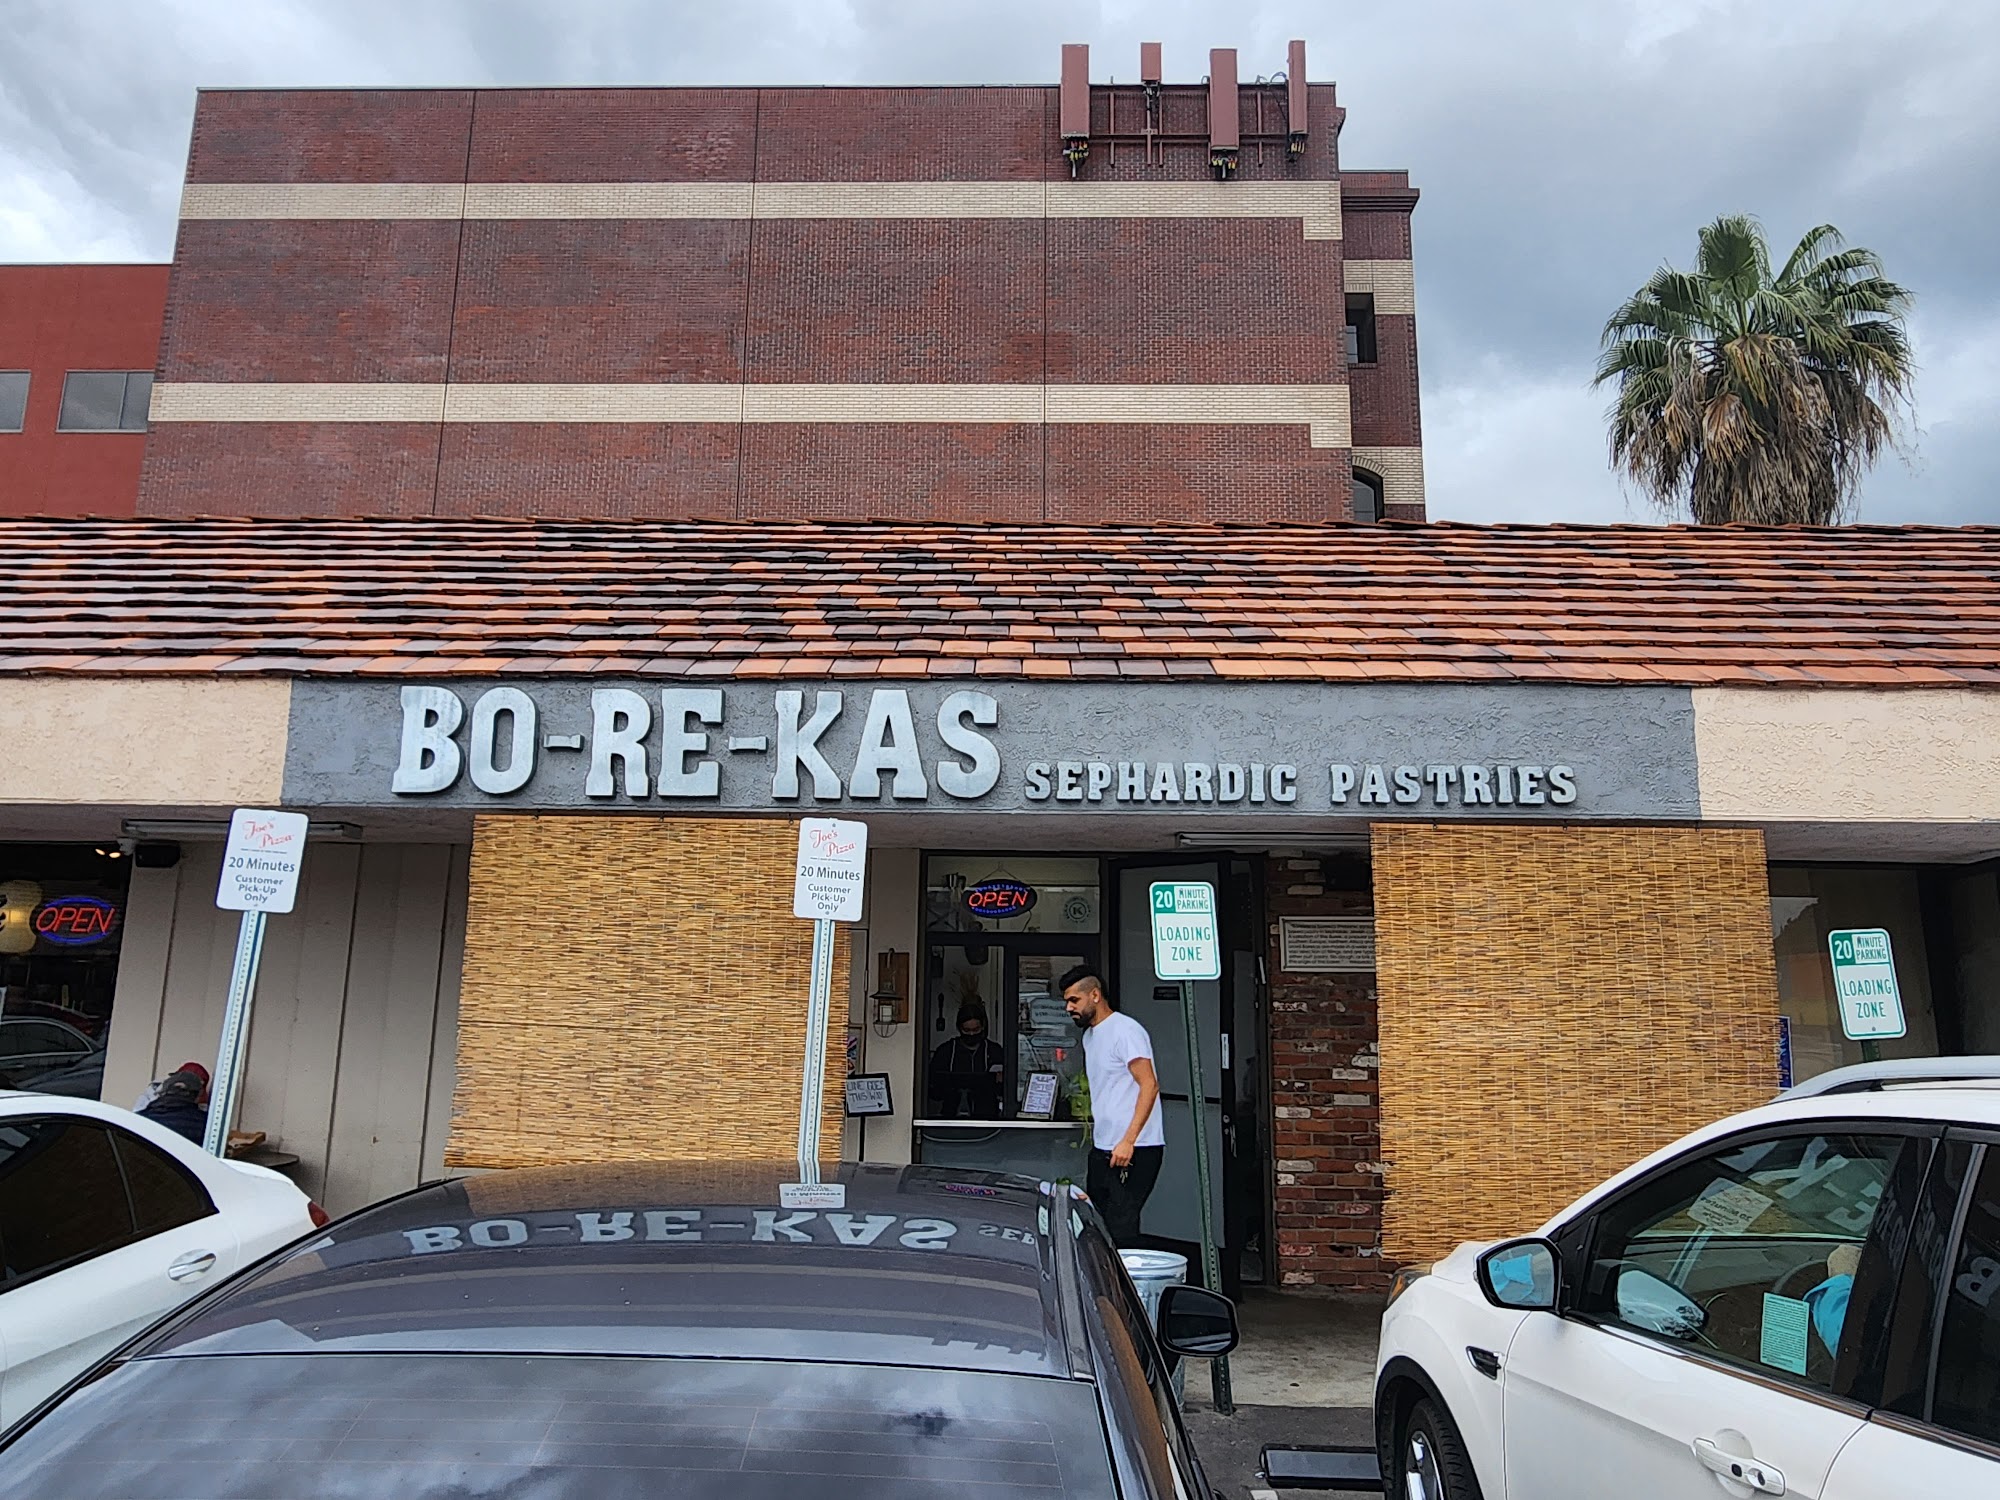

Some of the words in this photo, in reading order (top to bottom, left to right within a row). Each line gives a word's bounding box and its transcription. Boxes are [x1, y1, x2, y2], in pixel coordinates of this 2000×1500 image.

[391, 685, 1001, 799] BO-RE-KAS
[1025, 761, 1297, 802] SEPHARDIC
[1330, 764, 1577, 804] PASTRIES
[809, 829, 838, 849] Joe's
[823, 842, 855, 858] Pizza
[228, 856, 244, 868] 20
[246, 858, 295, 873] Minutes
[235, 874, 283, 885] Customer
[801, 865, 815, 877] 20
[817, 866, 861, 881] Minutes
[238, 884, 277, 895] Pick-Up
[808, 883, 852, 894] Customer
[1178, 888, 1206, 899] MINUTE
[244, 893, 268, 904] Only
[811, 893, 846, 903] Pick-Up
[968, 891, 1029, 907] OPEN
[1155, 890, 1174, 908] 20
[1177, 899, 1209, 910] PARKING
[818, 902, 839, 912] Only
[36, 907, 115, 933] OPEN
[1160, 926, 1211, 941] LOADING
[1835, 940, 1853, 959] 20
[1857, 936, 1884, 949] MINUTE
[1171, 946, 1203, 961] ZONE
[1856, 948, 1887, 960] PARKING
[1843, 979, 1892, 997] LOADING
[1856, 1002, 1887, 1018] ZONE
